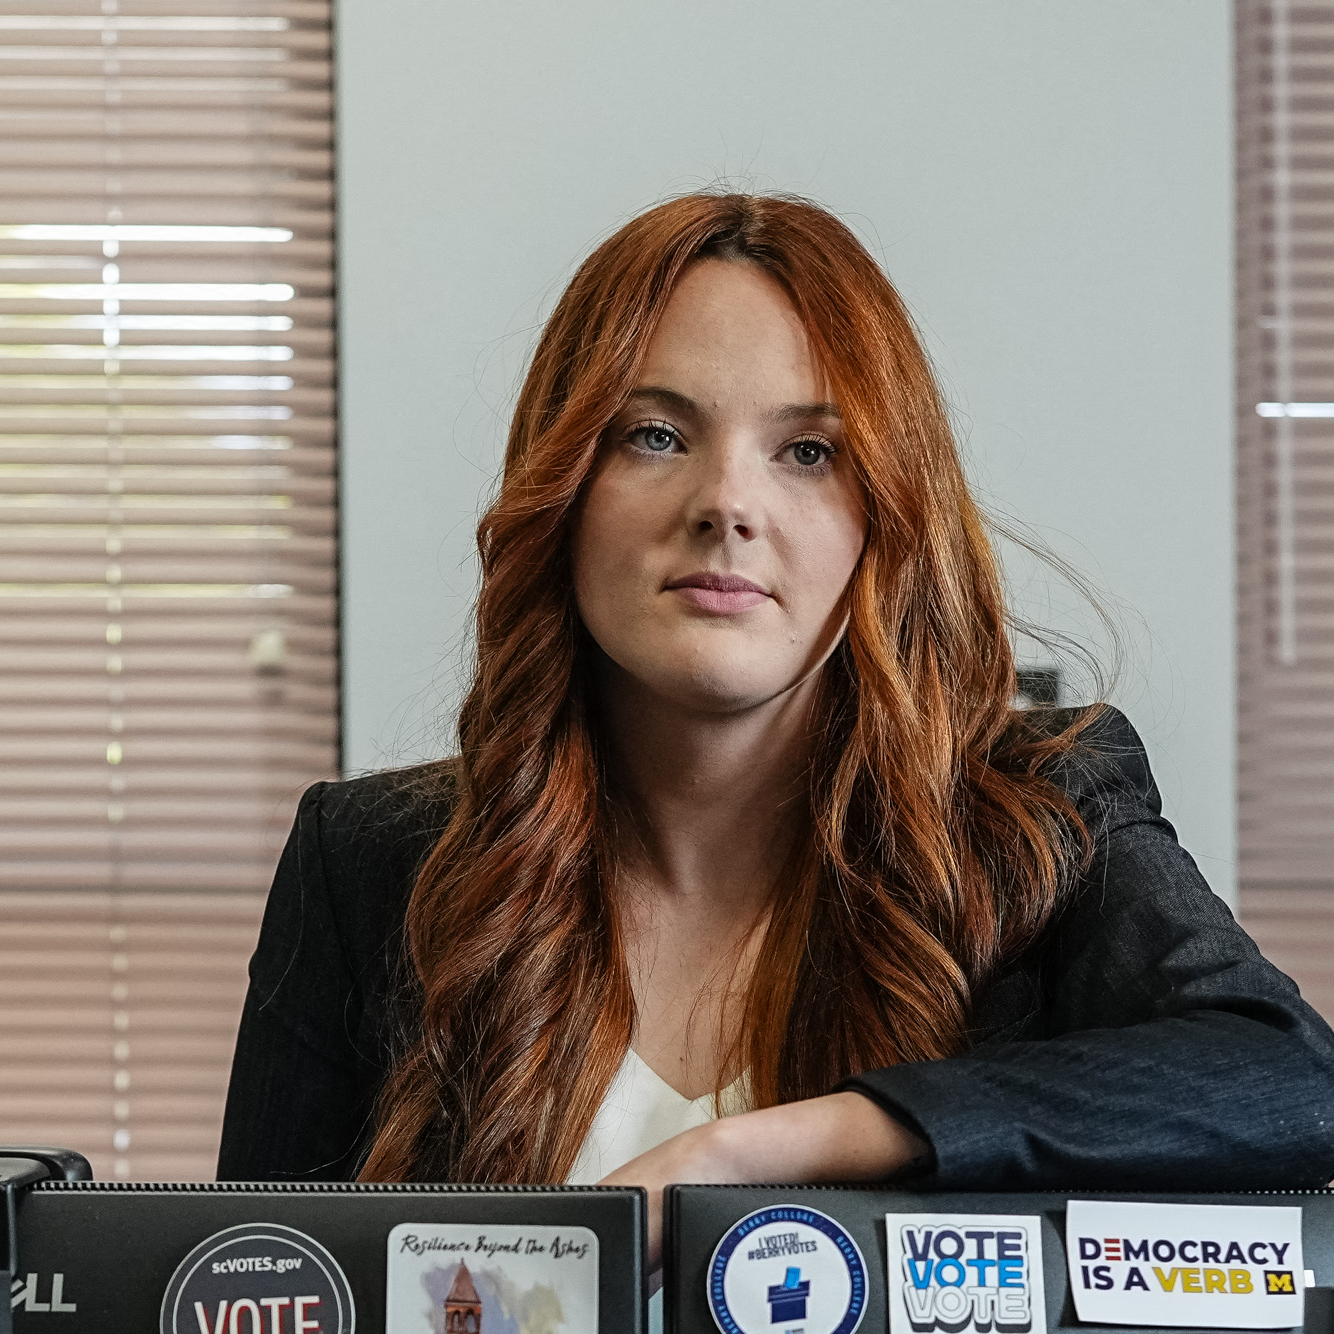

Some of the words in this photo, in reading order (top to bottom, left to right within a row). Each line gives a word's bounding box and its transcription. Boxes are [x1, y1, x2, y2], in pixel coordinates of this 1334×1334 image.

[737, 1215, 767, 1236] BERRY
[770, 1211, 815, 1223] COLLEGE
[400, 1234, 471, 1256] Resilience
[475, 1235, 522, 1258] Beyond
[524, 1239, 546, 1255] The
[549, 1235, 590, 1259] Ashes
[748, 1240, 818, 1261] #BERRYVOTES
[906, 1230, 1023, 1261] VOTE
[1078, 1237, 1290, 1265] DEMOCRACY
[212, 1257, 303, 1274] scVOTES.gov
[907, 1258, 1025, 1289] VOTE
[1081, 1265, 1114, 1291] IS
[1123, 1266, 1150, 1291] A
[1152, 1266, 1254, 1294] VERB
[908, 1285, 1027, 1320] VOTE
